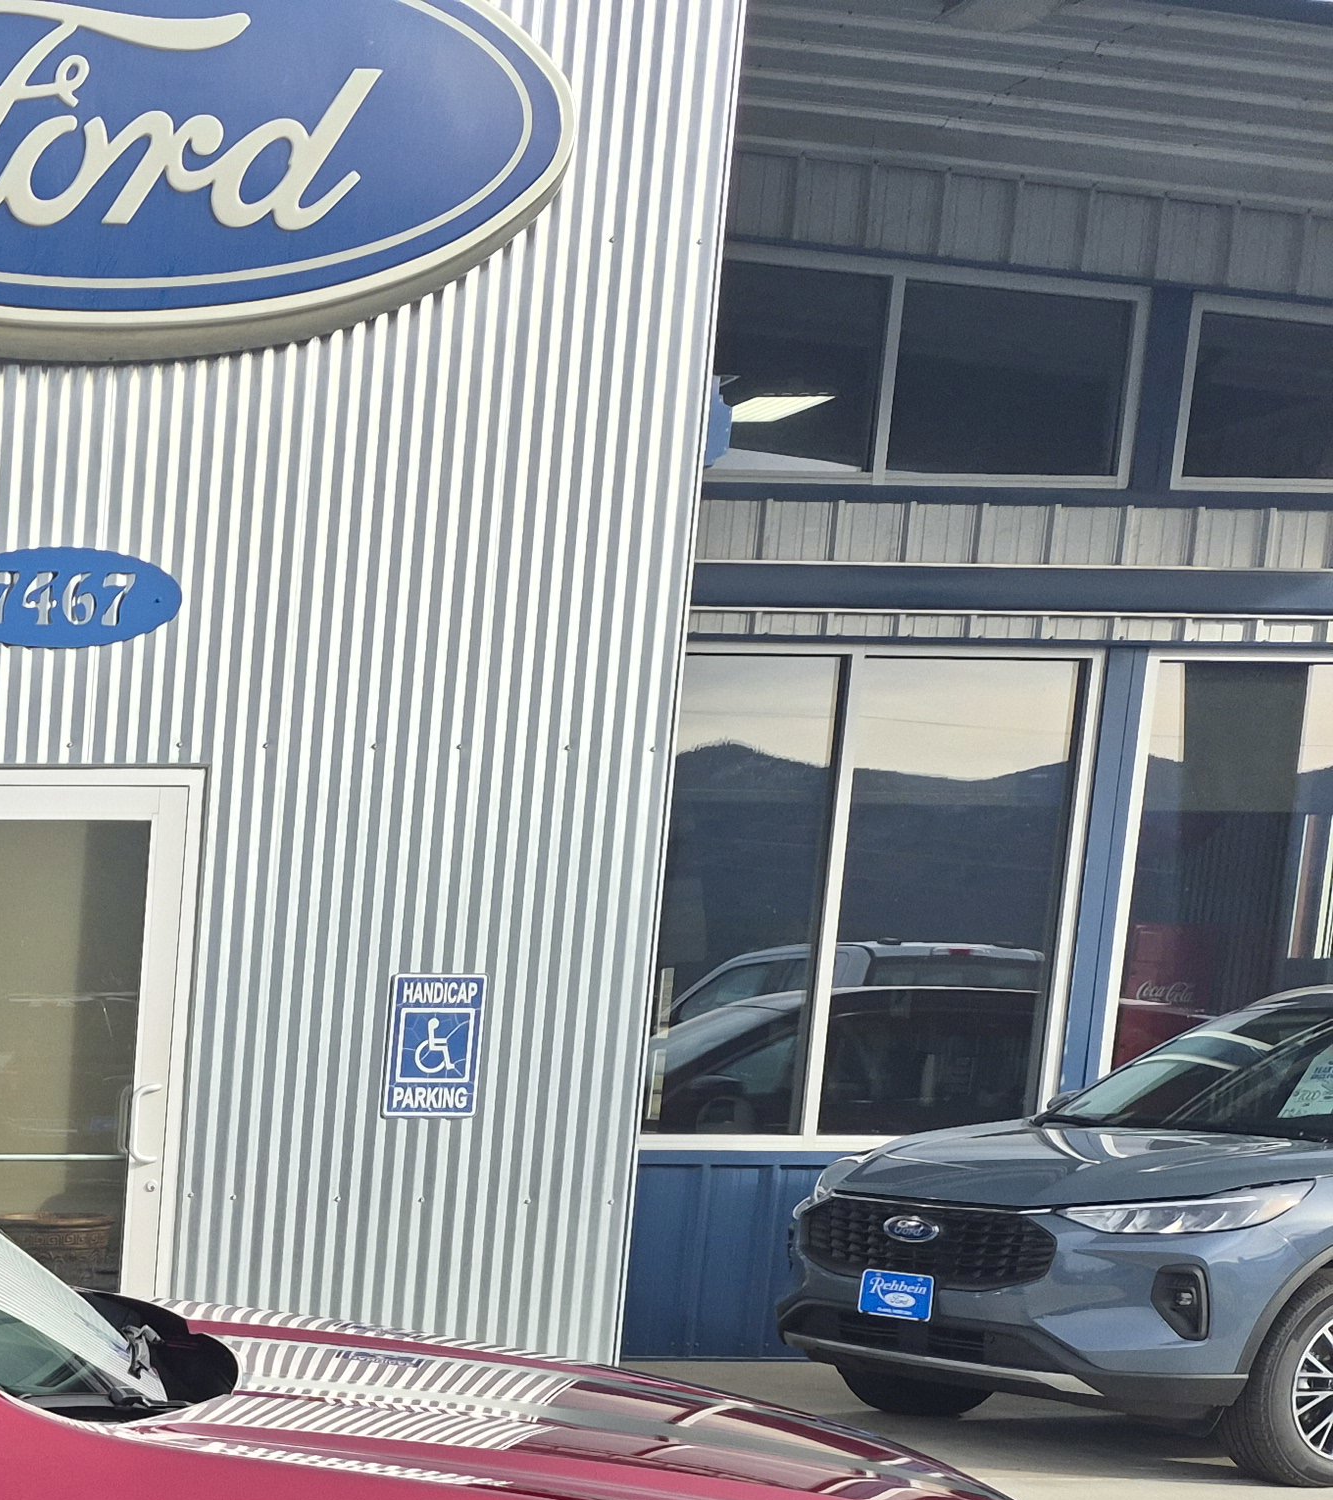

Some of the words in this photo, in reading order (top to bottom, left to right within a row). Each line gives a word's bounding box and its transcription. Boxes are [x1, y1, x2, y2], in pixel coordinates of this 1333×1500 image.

[403, 981, 478, 1004] HANDICAP
[392, 1086, 468, 1110] PARKING
[869, 1276, 927, 1297] Rehbein
